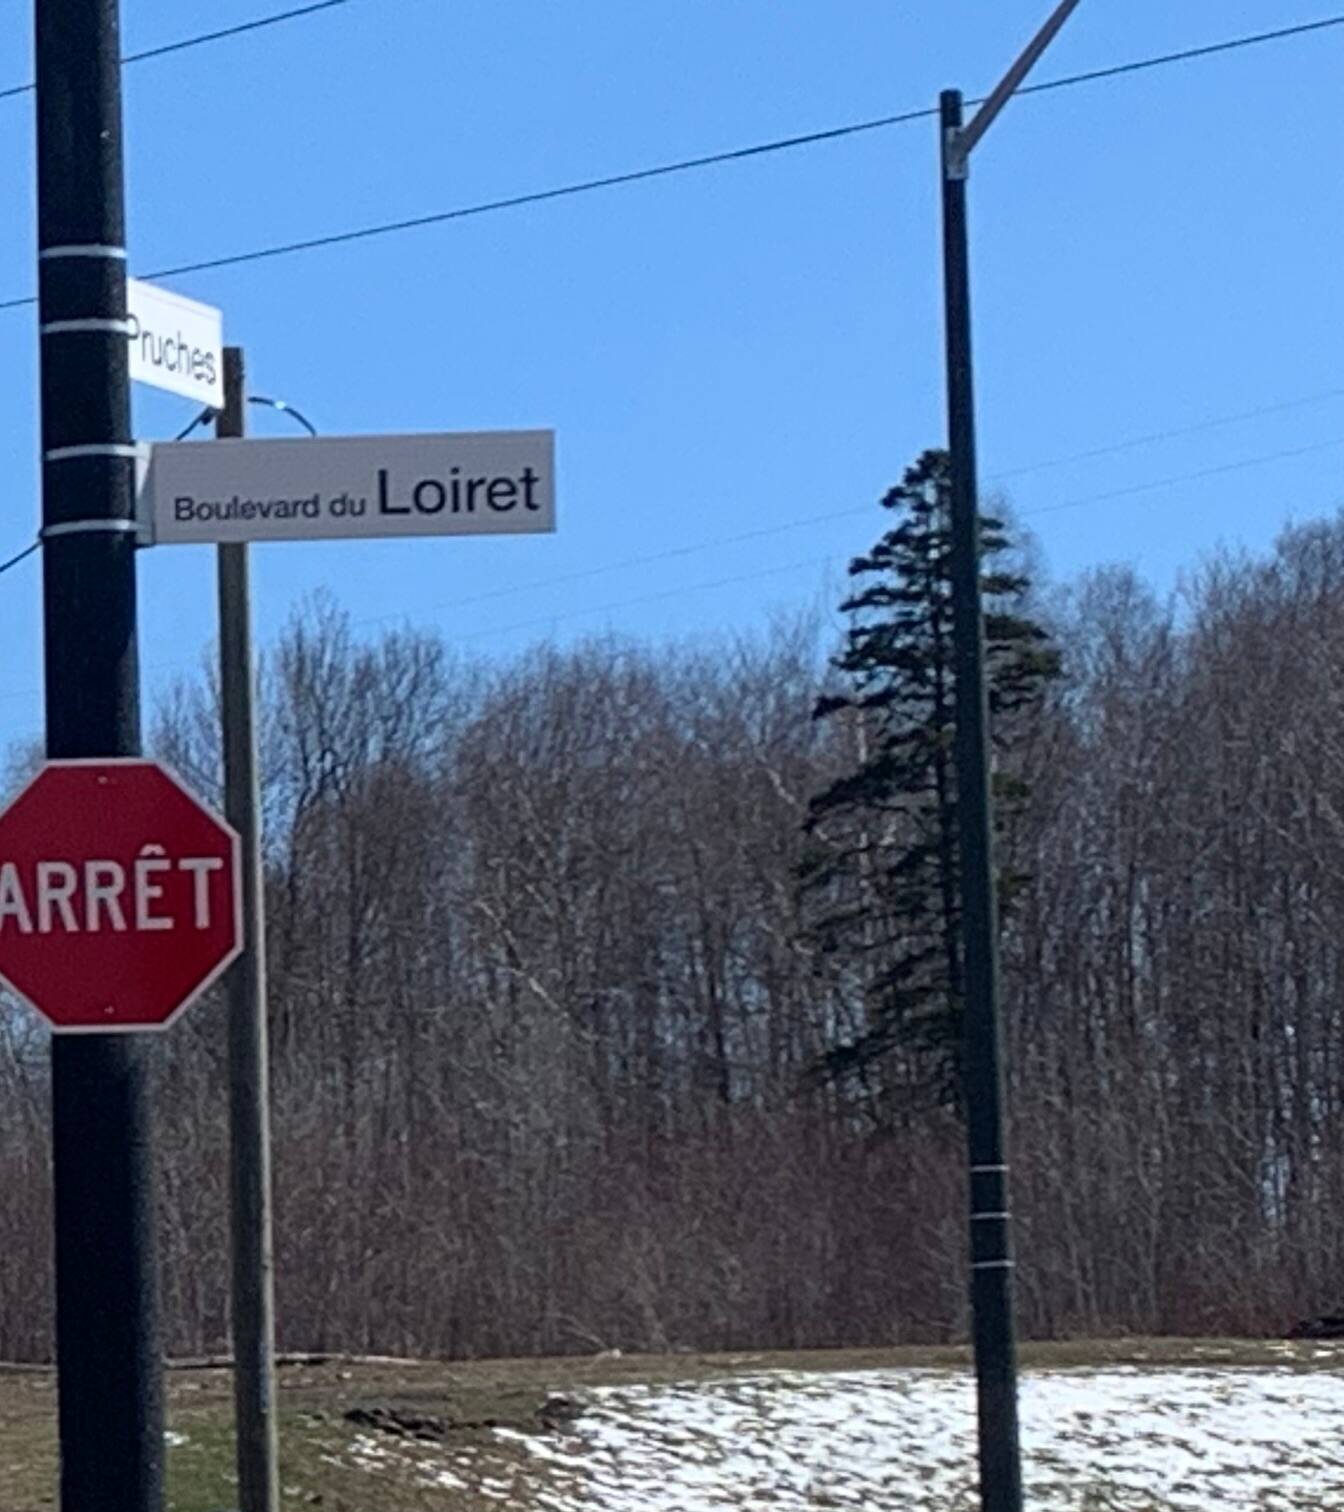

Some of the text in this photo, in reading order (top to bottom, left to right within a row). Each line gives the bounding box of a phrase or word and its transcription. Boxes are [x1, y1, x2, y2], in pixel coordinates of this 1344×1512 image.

[173, 467, 541, 523] Boulevard du Loiret
